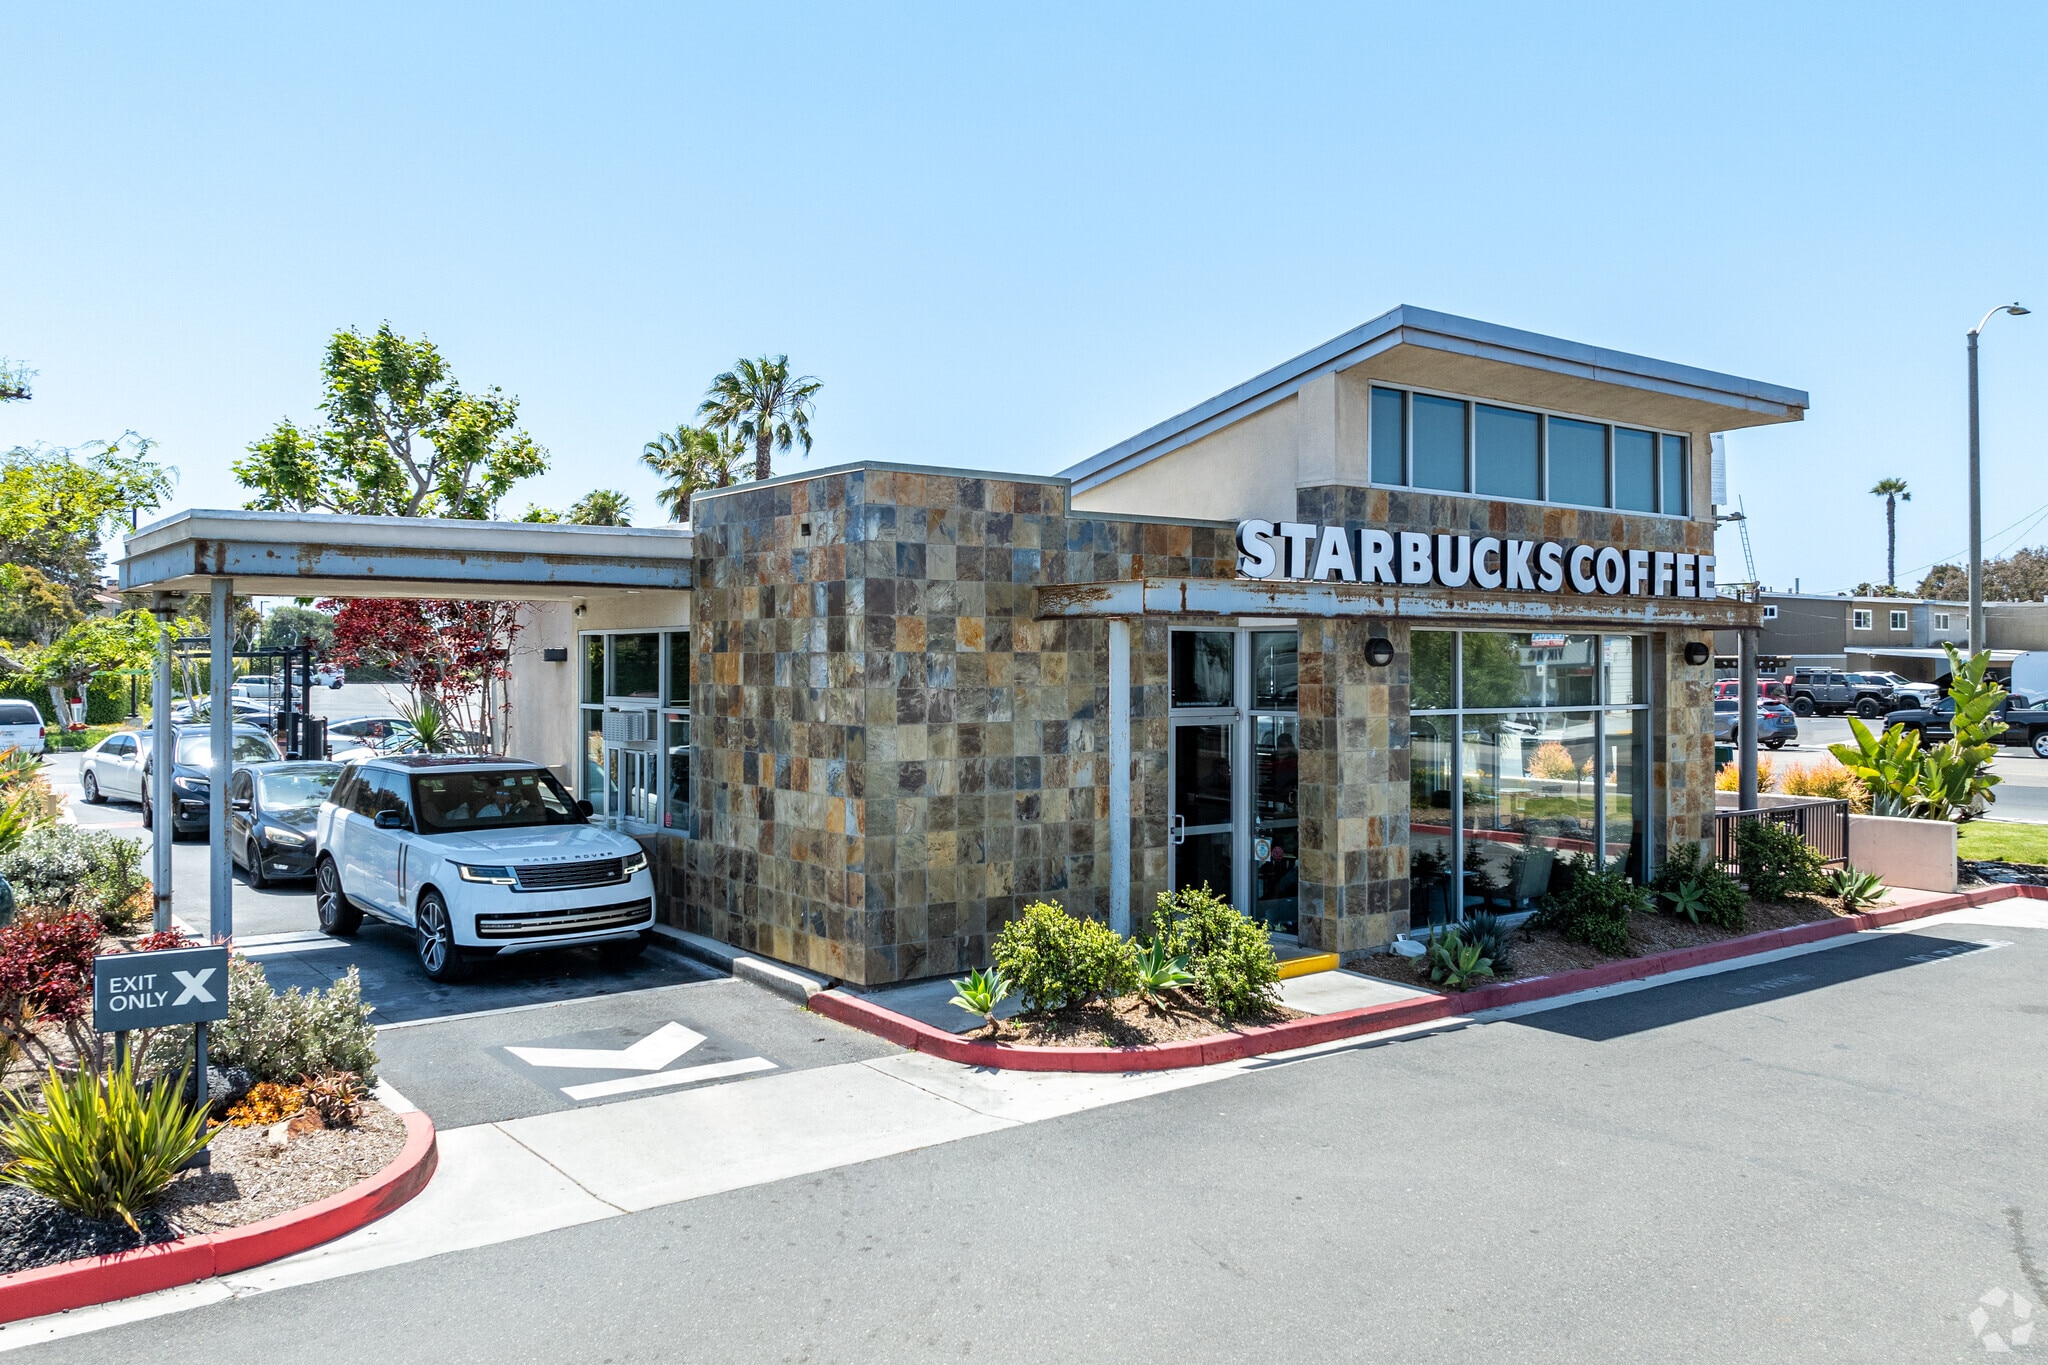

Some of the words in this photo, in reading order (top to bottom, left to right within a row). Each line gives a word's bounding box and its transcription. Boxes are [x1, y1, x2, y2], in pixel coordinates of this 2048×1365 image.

[1235, 518, 1563, 592] STARBUCKS
[1564, 544, 1717, 599] COFFEE
[574, 851, 614, 860] ROVER
[109, 973, 158, 994] EXIT
[109, 990, 169, 1012] ONLY
